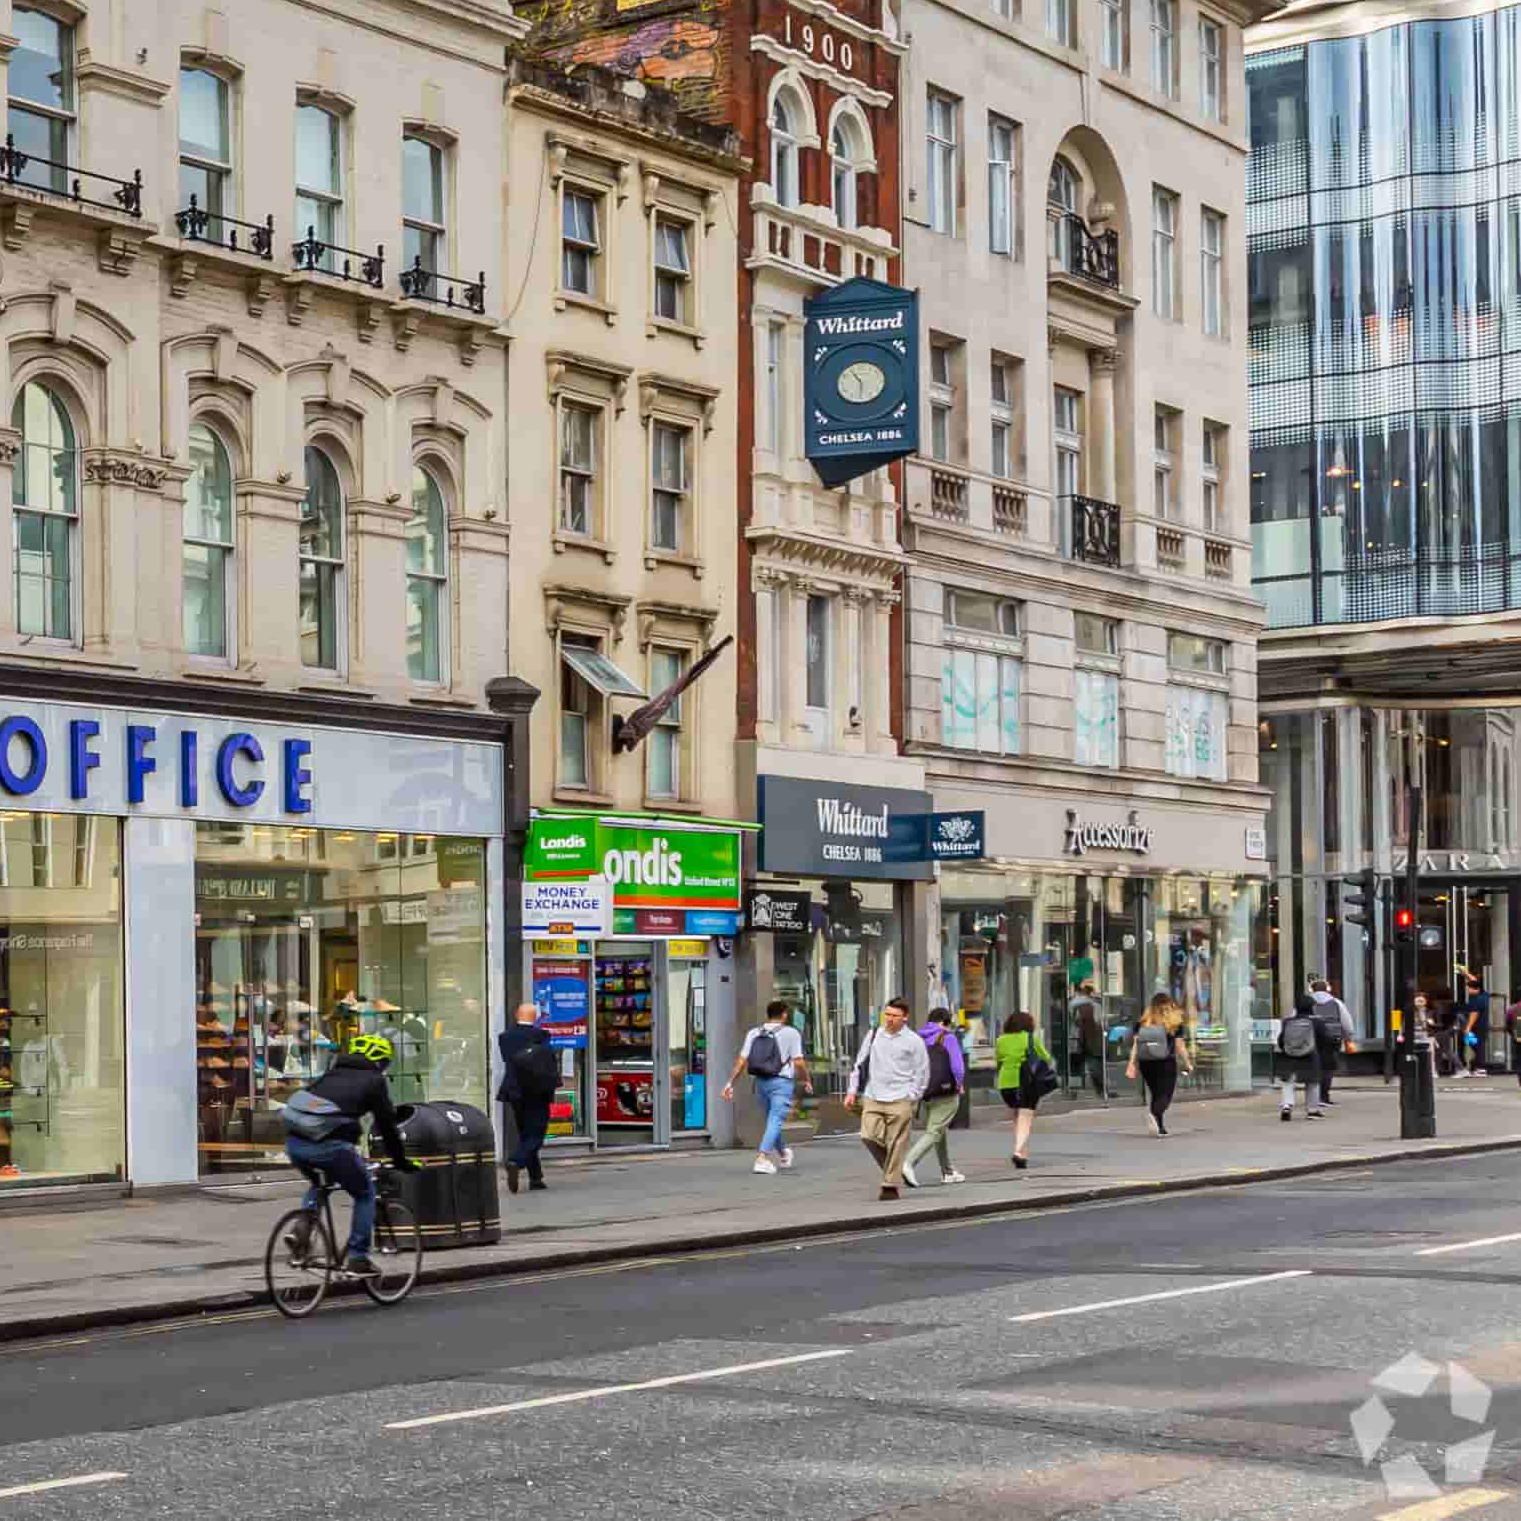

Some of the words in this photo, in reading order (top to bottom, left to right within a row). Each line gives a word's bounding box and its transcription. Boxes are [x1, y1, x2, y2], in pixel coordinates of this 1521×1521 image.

[786, 14, 853, 70] 1900
[817, 311, 903, 334] Whittard
[819, 433, 873, 444] CHELSEA
[817, 798, 888, 838] Whittard
[540, 834, 586, 849] Londis
[932, 840, 980, 852] Whittard
[823, 844, 860, 861] CHELSEA
[604, 838, 682, 886] ondis
[537, 886, 587, 899] MONEY
[525, 898, 600, 910] EXCHANGE
[774, 901, 798, 911] WEST
